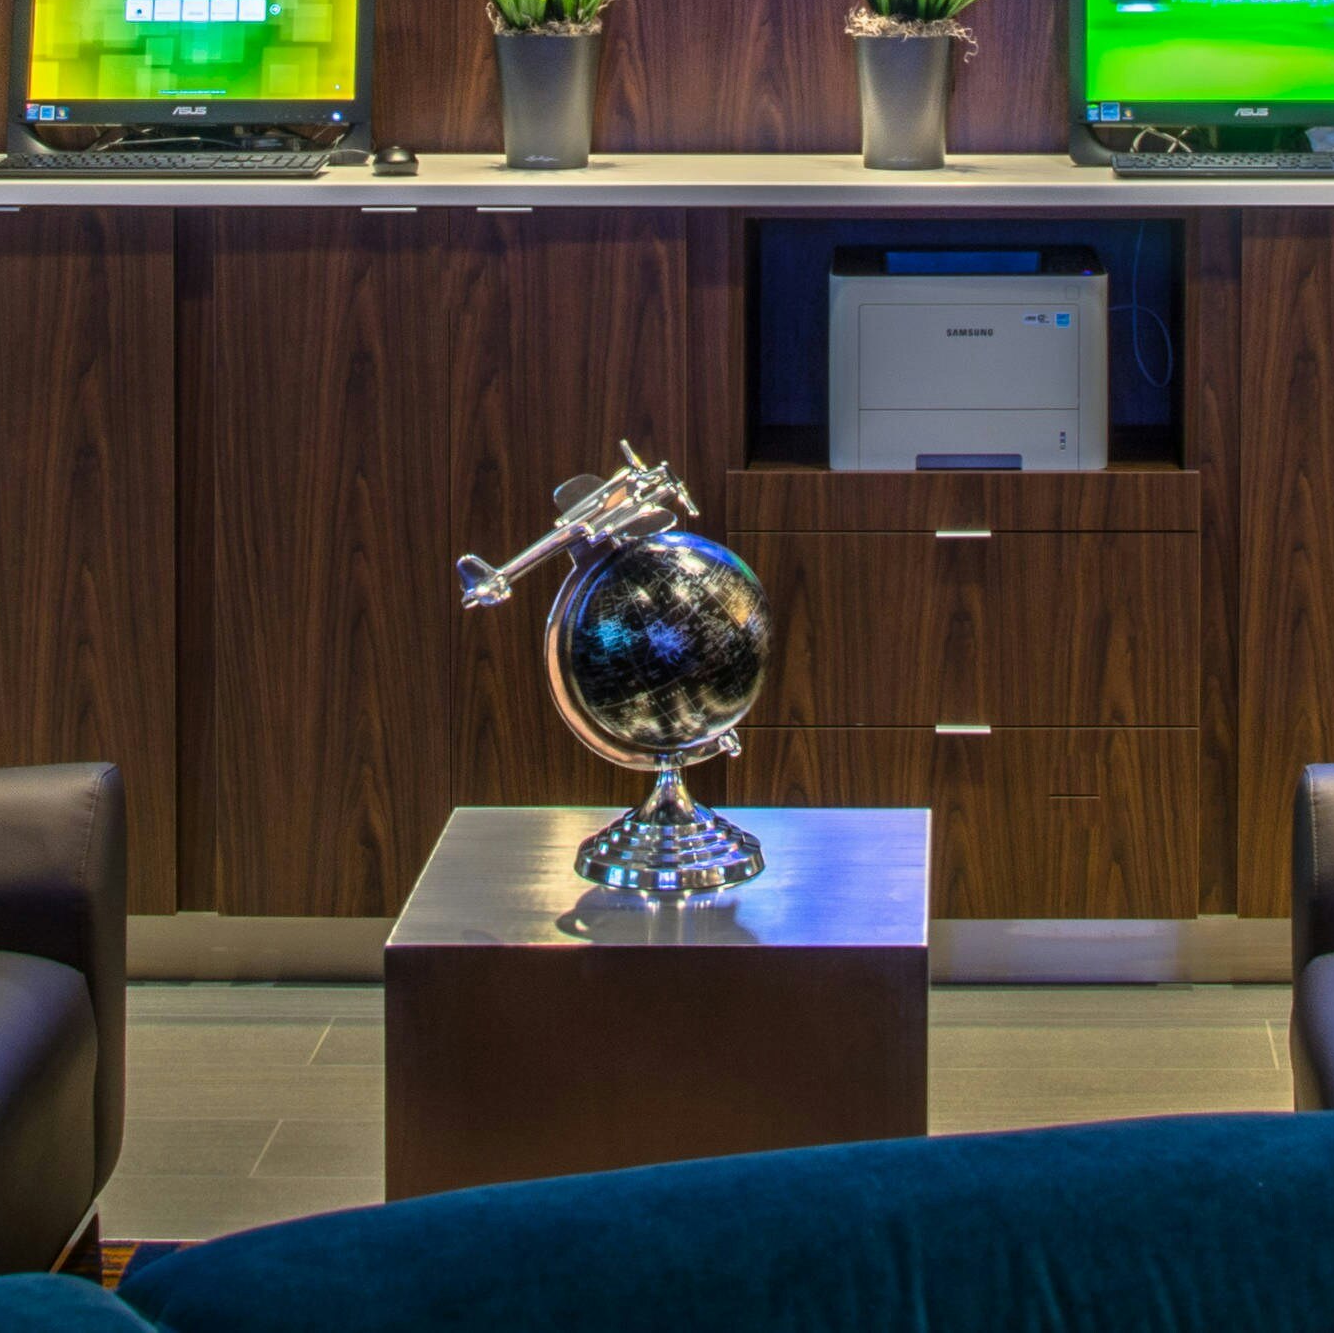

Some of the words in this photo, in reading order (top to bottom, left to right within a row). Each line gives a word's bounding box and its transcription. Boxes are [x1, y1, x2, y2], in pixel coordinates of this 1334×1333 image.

[172, 106, 207, 116] ASUS
[1234, 107, 1269, 117] ASUS
[946, 328, 994, 337] SAMSUNG
